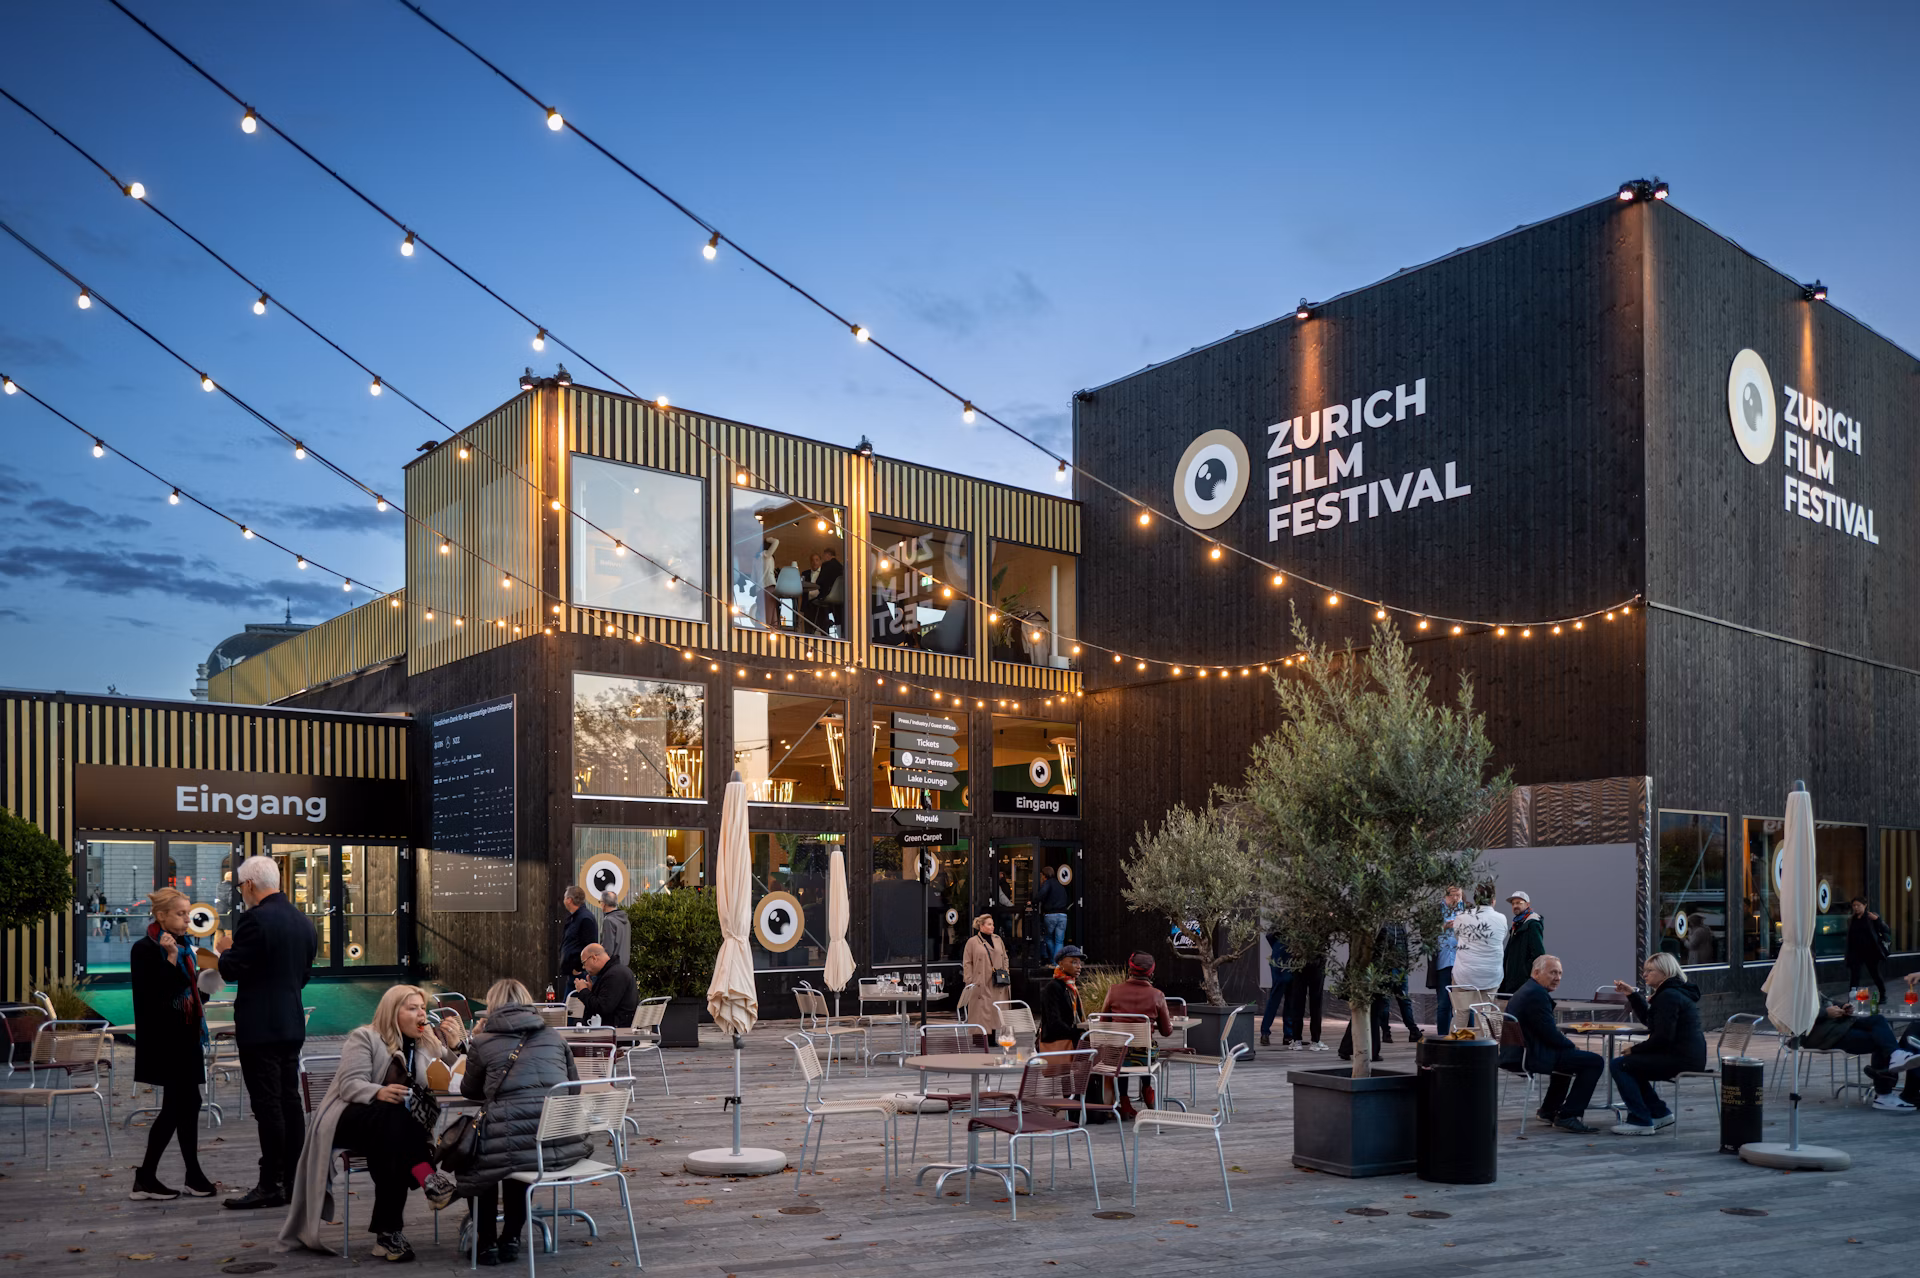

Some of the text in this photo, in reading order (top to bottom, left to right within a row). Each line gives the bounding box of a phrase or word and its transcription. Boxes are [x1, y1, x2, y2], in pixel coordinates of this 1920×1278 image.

[1267, 378, 1426, 459] ZURICH
[1784, 385, 1861, 455] ZURICH
[1784, 430, 1834, 485] FILM
[1268, 441, 1363, 500] FILM
[1268, 461, 1472, 543] FESTIVAL
[1784, 474, 1879, 545] FESTIVAL
[450, 715, 458, 723] Dank
[912, 719, 928, 728] Industry
[916, 738, 940, 749] Tickets
[915, 756, 953, 768] Zur Terrasse
[907, 774, 948, 786] Lake Lounge
[176, 784, 327, 823] Eingang
[1016, 796, 1060, 813] Eingang
[915, 813, 939, 823] Napulé
[904, 833, 943, 843] Green Carpet
